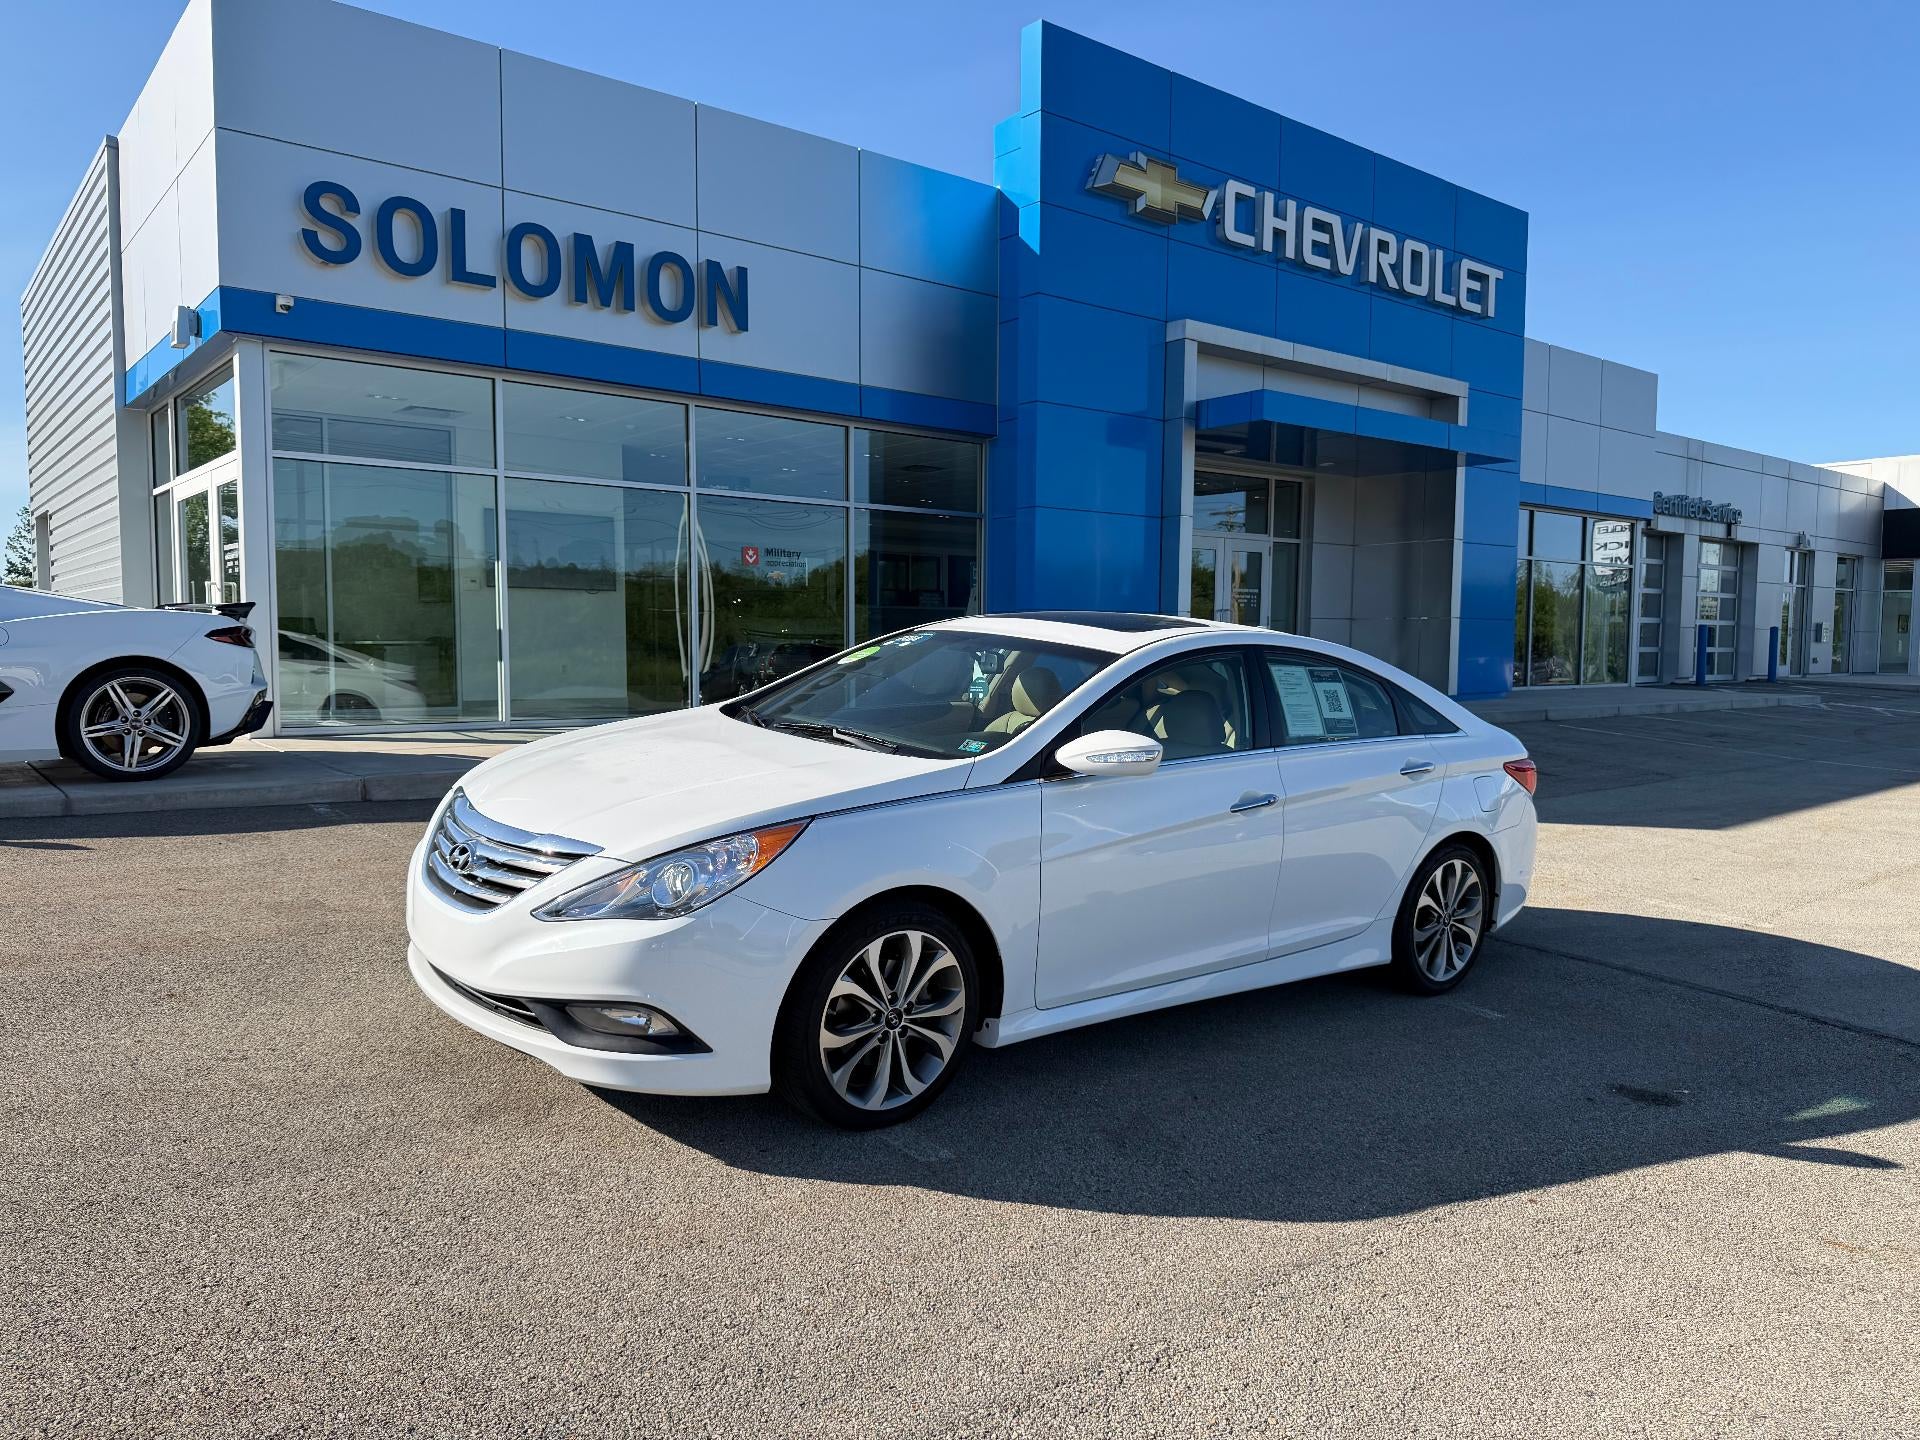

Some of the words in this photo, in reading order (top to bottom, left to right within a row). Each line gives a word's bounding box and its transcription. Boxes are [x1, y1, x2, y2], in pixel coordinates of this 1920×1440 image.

[299, 180, 749, 334] SOLOMON
[1219, 178, 1504, 318] CHEVROLET
[1654, 491, 1703, 519] Certified
[1704, 499, 1743, 525] Service
[766, 547, 801, 559] Military
